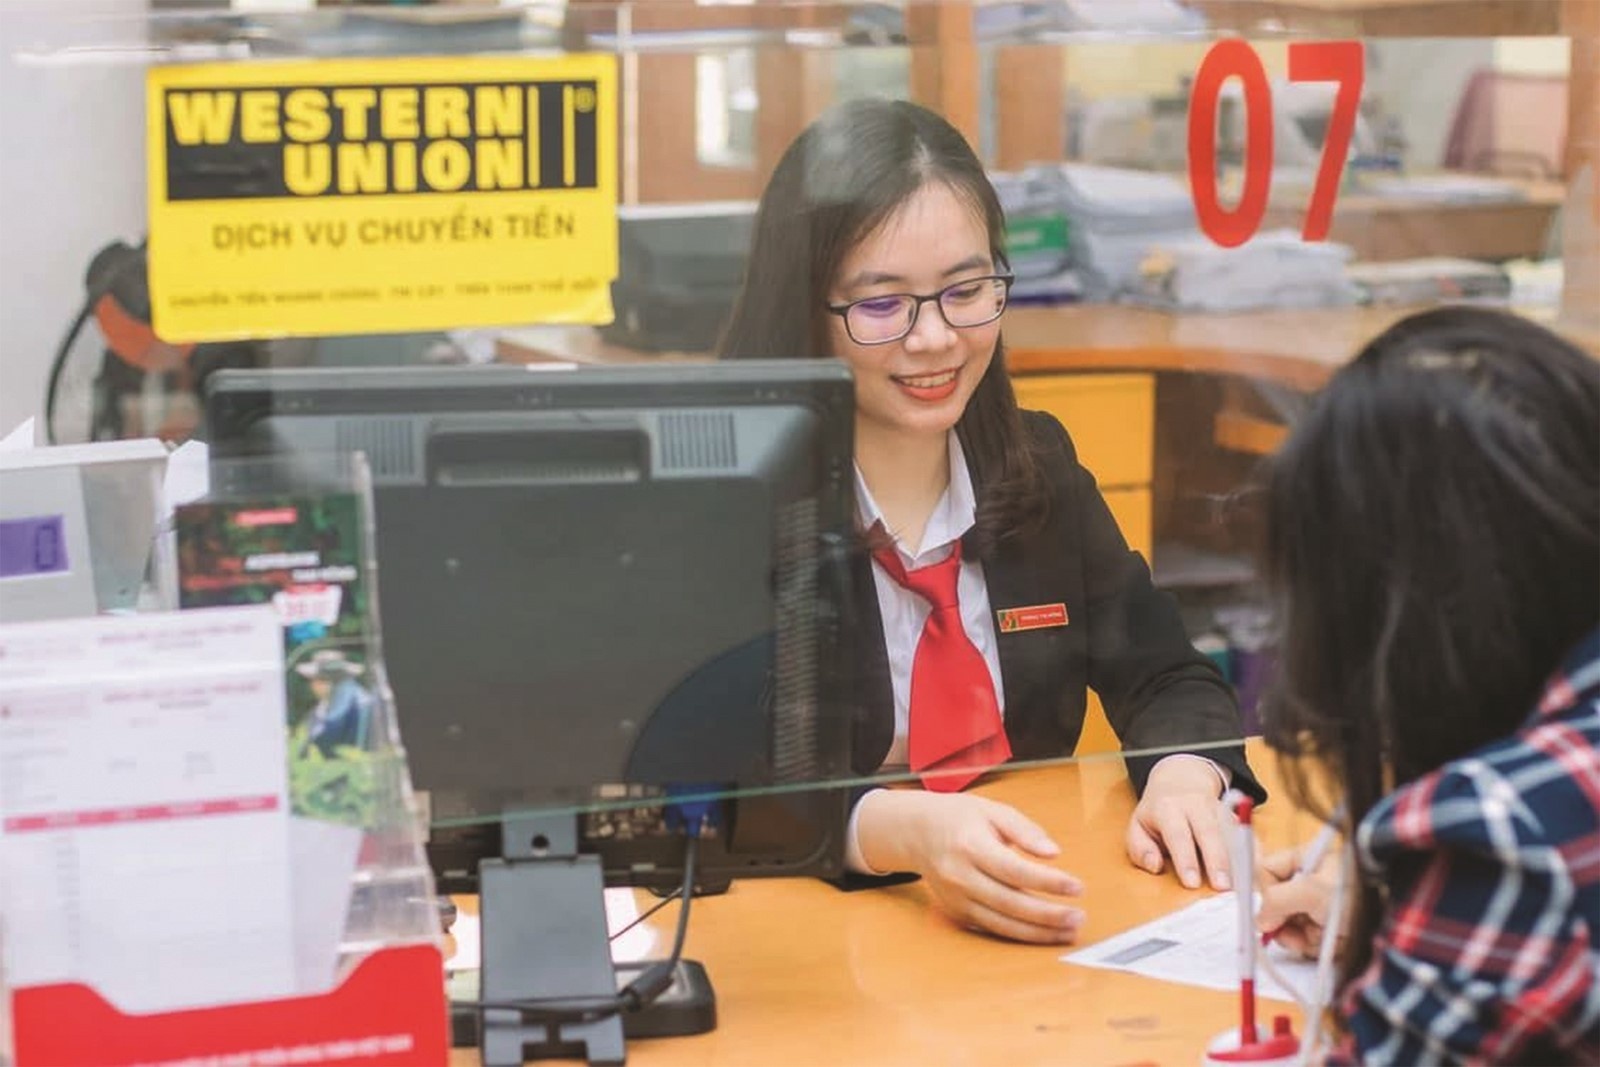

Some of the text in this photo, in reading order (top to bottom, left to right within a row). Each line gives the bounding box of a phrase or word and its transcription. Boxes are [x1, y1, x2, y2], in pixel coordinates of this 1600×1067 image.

[167, 84, 524, 146] WESTERN
[1187, 38, 1365, 248] 07
[283, 138, 524, 195] UNION
